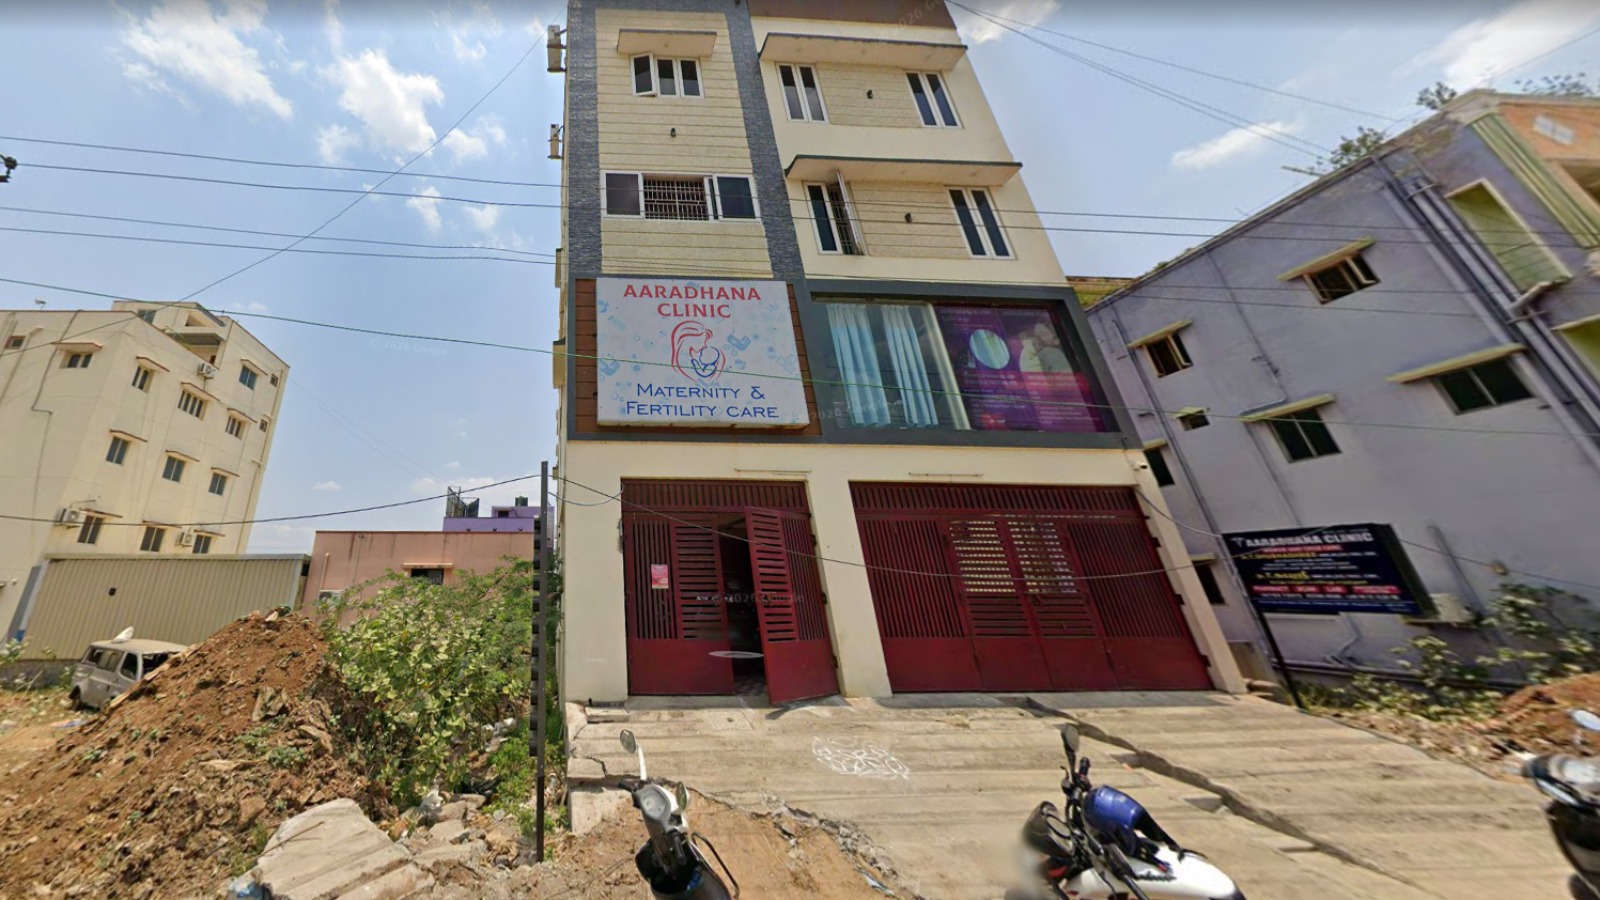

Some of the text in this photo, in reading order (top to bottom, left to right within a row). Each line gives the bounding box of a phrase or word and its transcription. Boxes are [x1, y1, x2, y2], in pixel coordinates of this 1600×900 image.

[623, 284, 762, 300] AARADHANA
[657, 303, 731, 318] CLINIC
[750, 386, 766, 400] &
[726, 406, 779, 418] CARE
